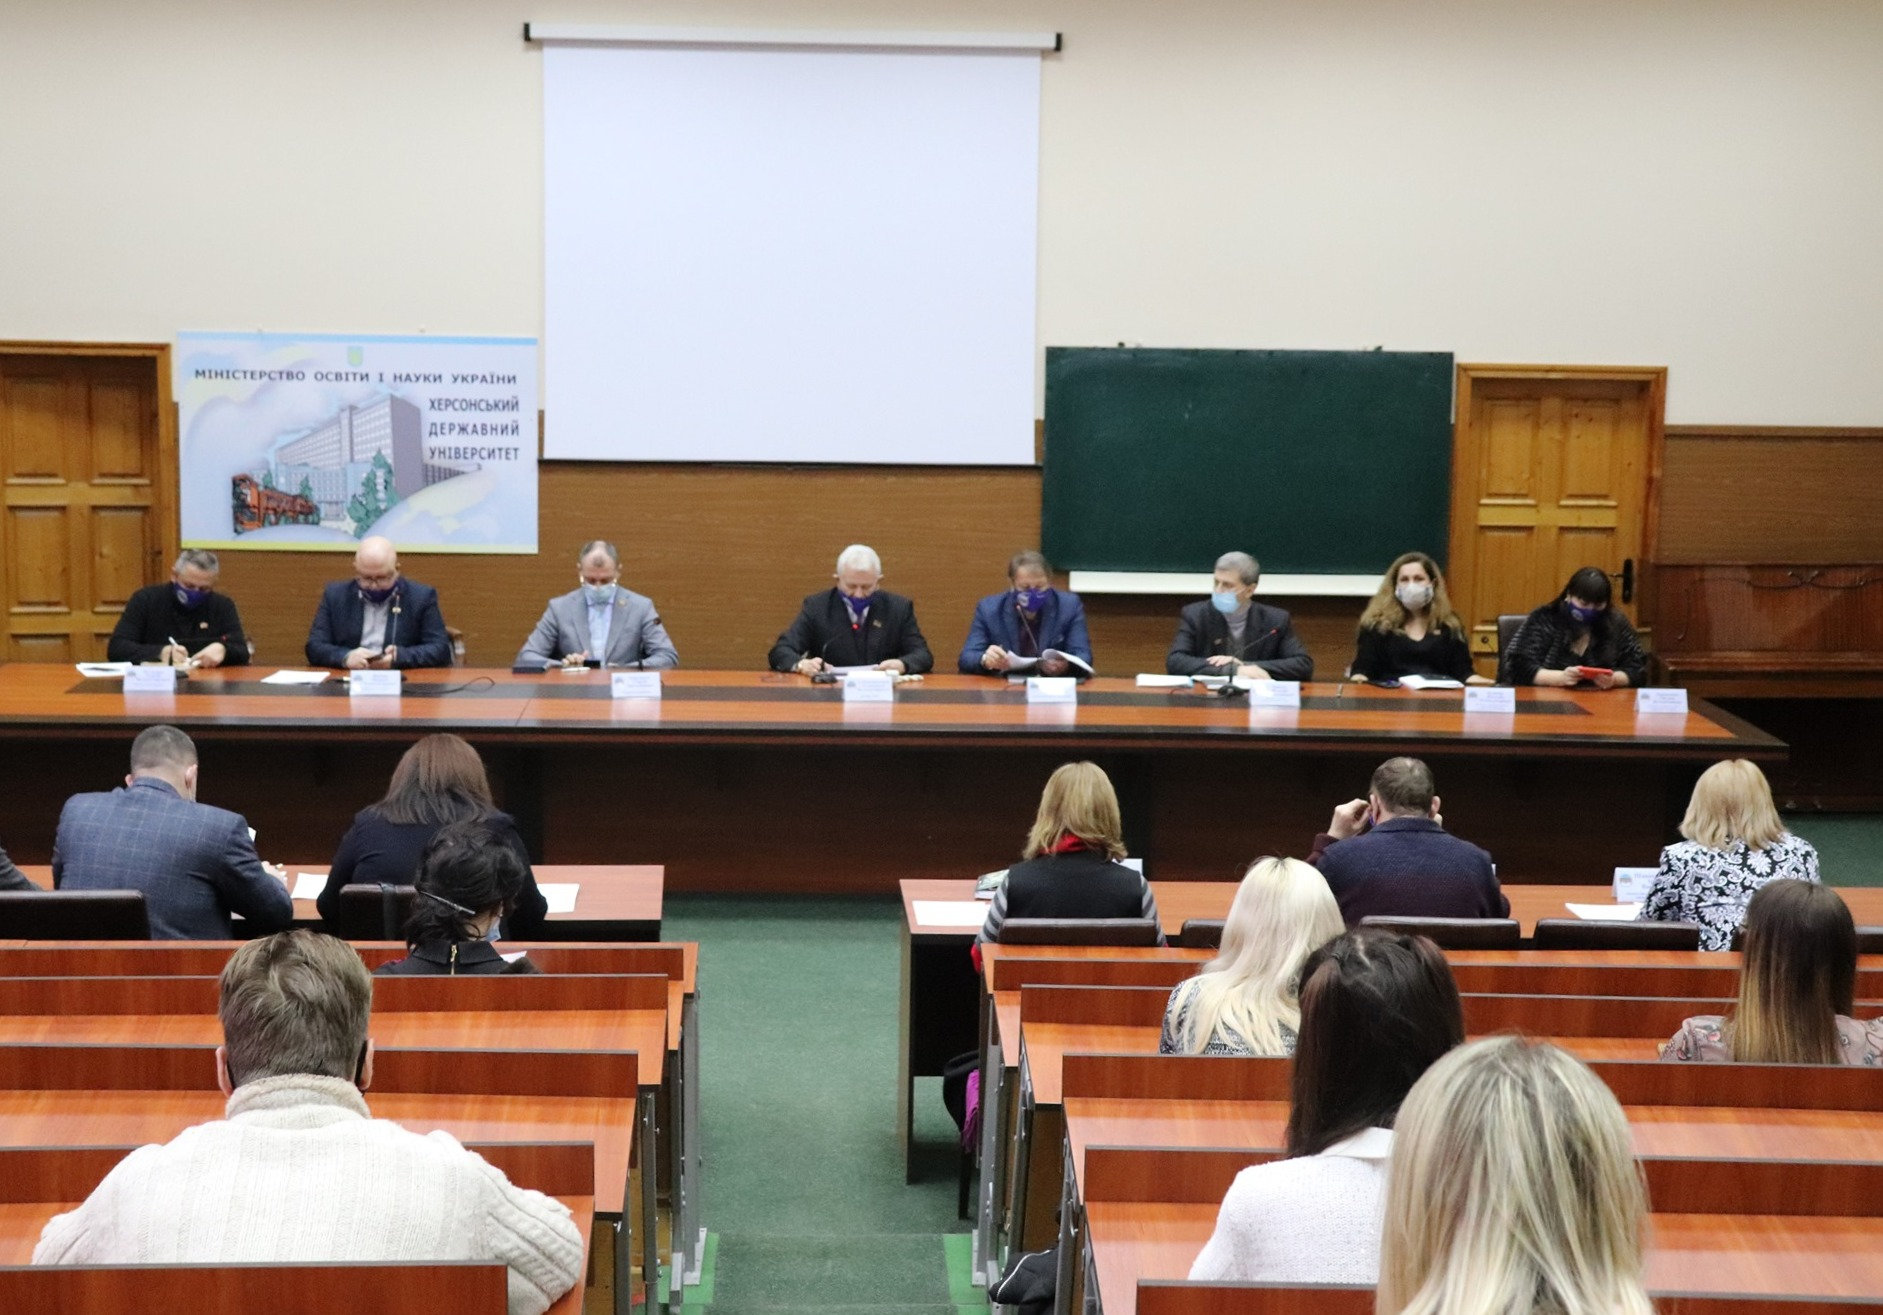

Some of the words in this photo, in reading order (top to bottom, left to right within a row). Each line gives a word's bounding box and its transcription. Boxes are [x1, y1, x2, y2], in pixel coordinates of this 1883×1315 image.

[195, 368, 306, 382] МІНІСТЕРСТВО
[314, 371, 370, 383] ОСВІТИ
[393, 372, 443, 384] НАУКИ
[451, 372, 517, 385] УКРАЇНИ
[429, 395, 520, 412] ХЕРСОНСЬКИЙ
[429, 421, 520, 437] ДЕРЖАВНИЙ
[429, 446, 520, 461] УНІВЕРСИТЕТ
